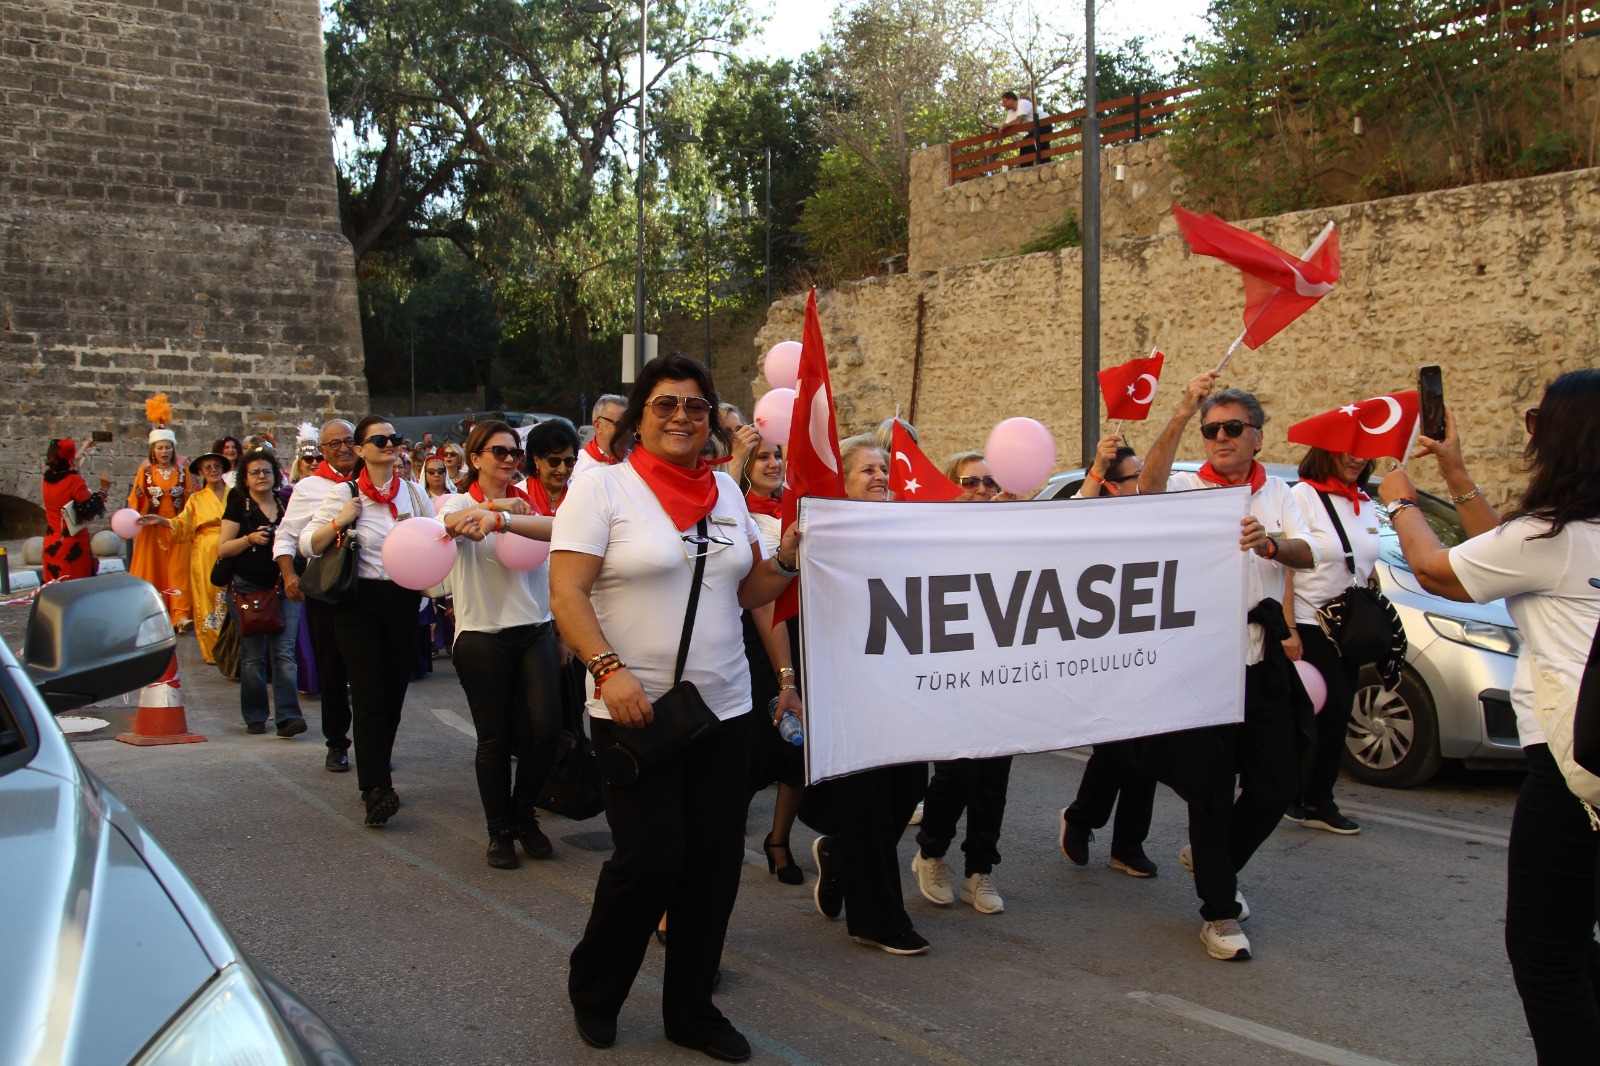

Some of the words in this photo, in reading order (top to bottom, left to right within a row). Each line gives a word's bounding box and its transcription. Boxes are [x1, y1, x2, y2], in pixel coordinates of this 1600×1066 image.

[865, 560, 1196, 655] NEVASEL
[915, 671, 971, 691] TÜRK
[981, 660, 1048, 687] MÜZİĞİ
[1057, 648, 1157, 678] TOPLULUĞU
